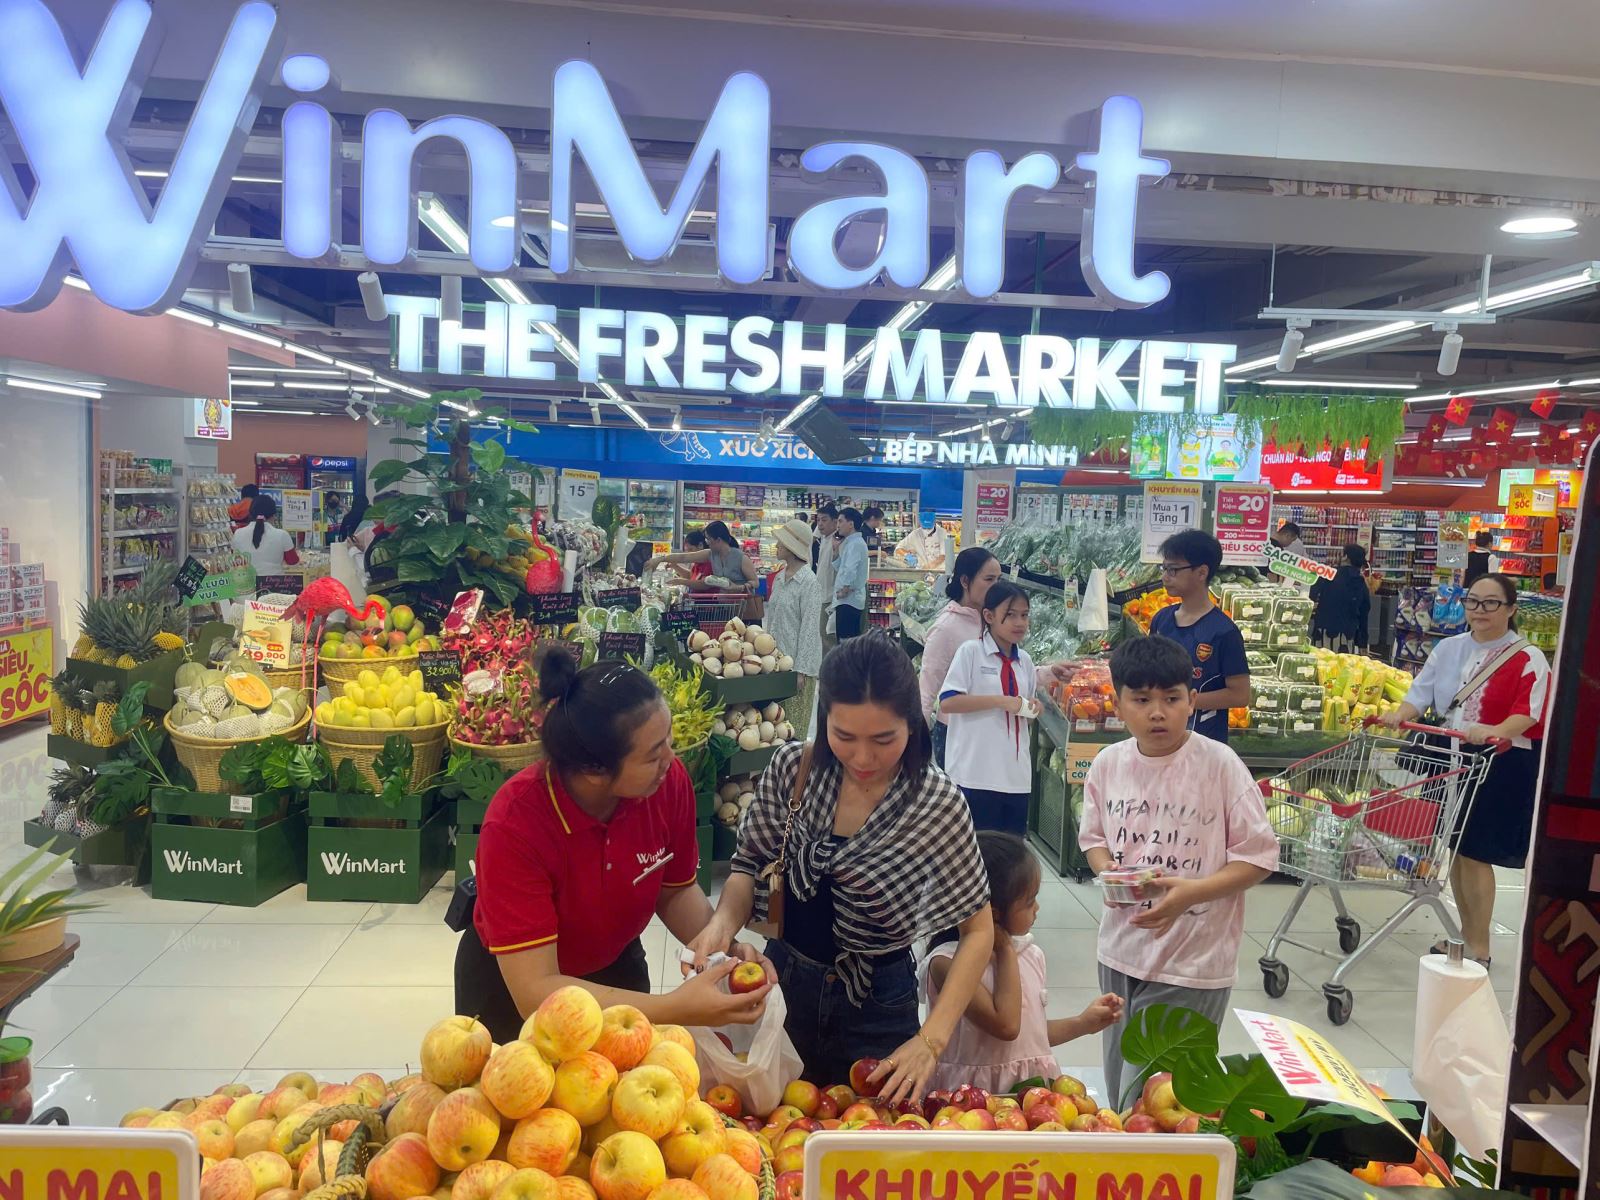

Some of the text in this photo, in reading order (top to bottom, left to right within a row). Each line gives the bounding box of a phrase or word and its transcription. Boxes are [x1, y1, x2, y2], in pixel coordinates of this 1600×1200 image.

[0, 0, 1172, 313] WinMart
[385, 294, 1238, 415] THE FRESH MARKET
[569, 485, 585, 497] 15
[301, 501, 307, 510] 1
[1152, 503, 1172, 512] Mua
[1153, 505, 1190, 525] Tặng 1
[1298, 558, 1336, 580] NGON
[1, 664, 48, 720] SỐC
[163, 849, 243, 875] WinMart
[320, 852, 406, 875] WinMart
[1250, 1019, 1322, 1086] WinMart
[835, 1159, 1079, 1200] KHUYẾN
